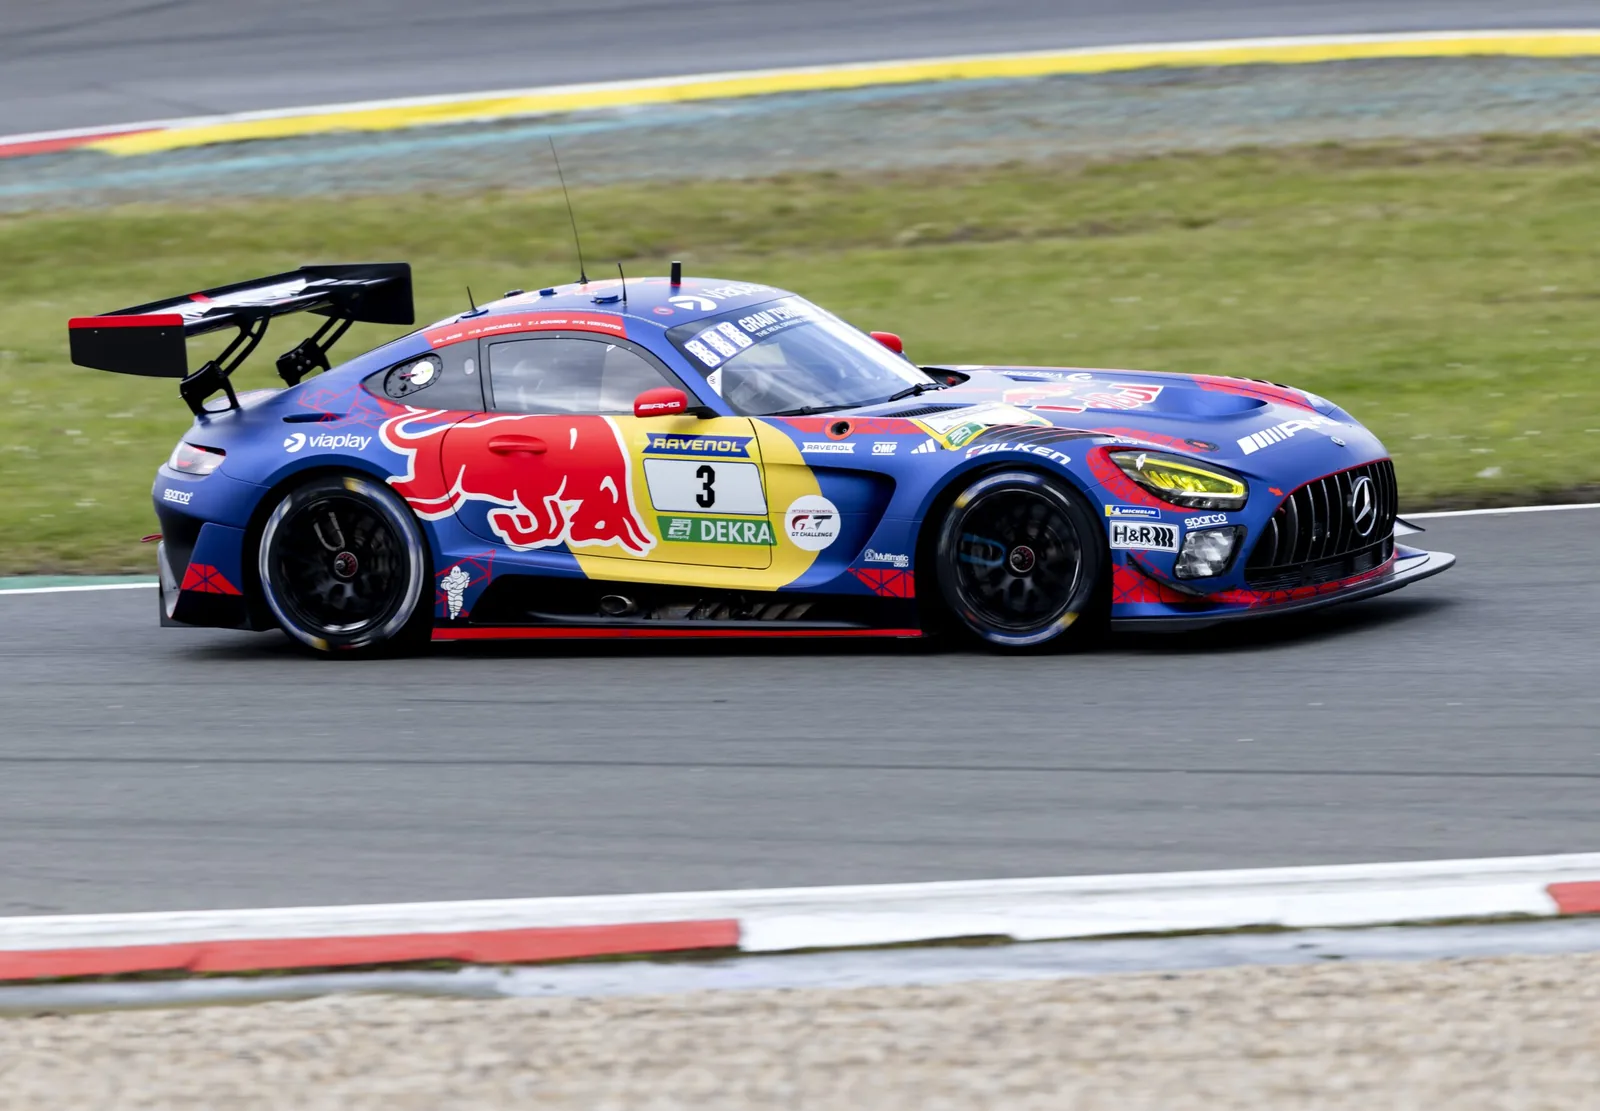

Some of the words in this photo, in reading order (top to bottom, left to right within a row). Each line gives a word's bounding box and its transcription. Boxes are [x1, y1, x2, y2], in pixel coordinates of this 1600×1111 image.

[738, 311, 777, 333] GRAN
[652, 401, 681, 409] AMG
[309, 433, 373, 451] viaplay
[652, 437, 742, 453] RAVENOL
[872, 443, 897, 454] OMP
[965, 442, 1072, 465] FALKEN
[695, 465, 716, 508] 3
[163, 488, 191, 503] sparco
[1121, 507, 1156, 516] MICHELIN
[1184, 512, 1227, 529] sparco
[700, 520, 774, 544] DEKRA
[1113, 525, 1152, 543] H&R
[873, 552, 909, 562] Multimatic
